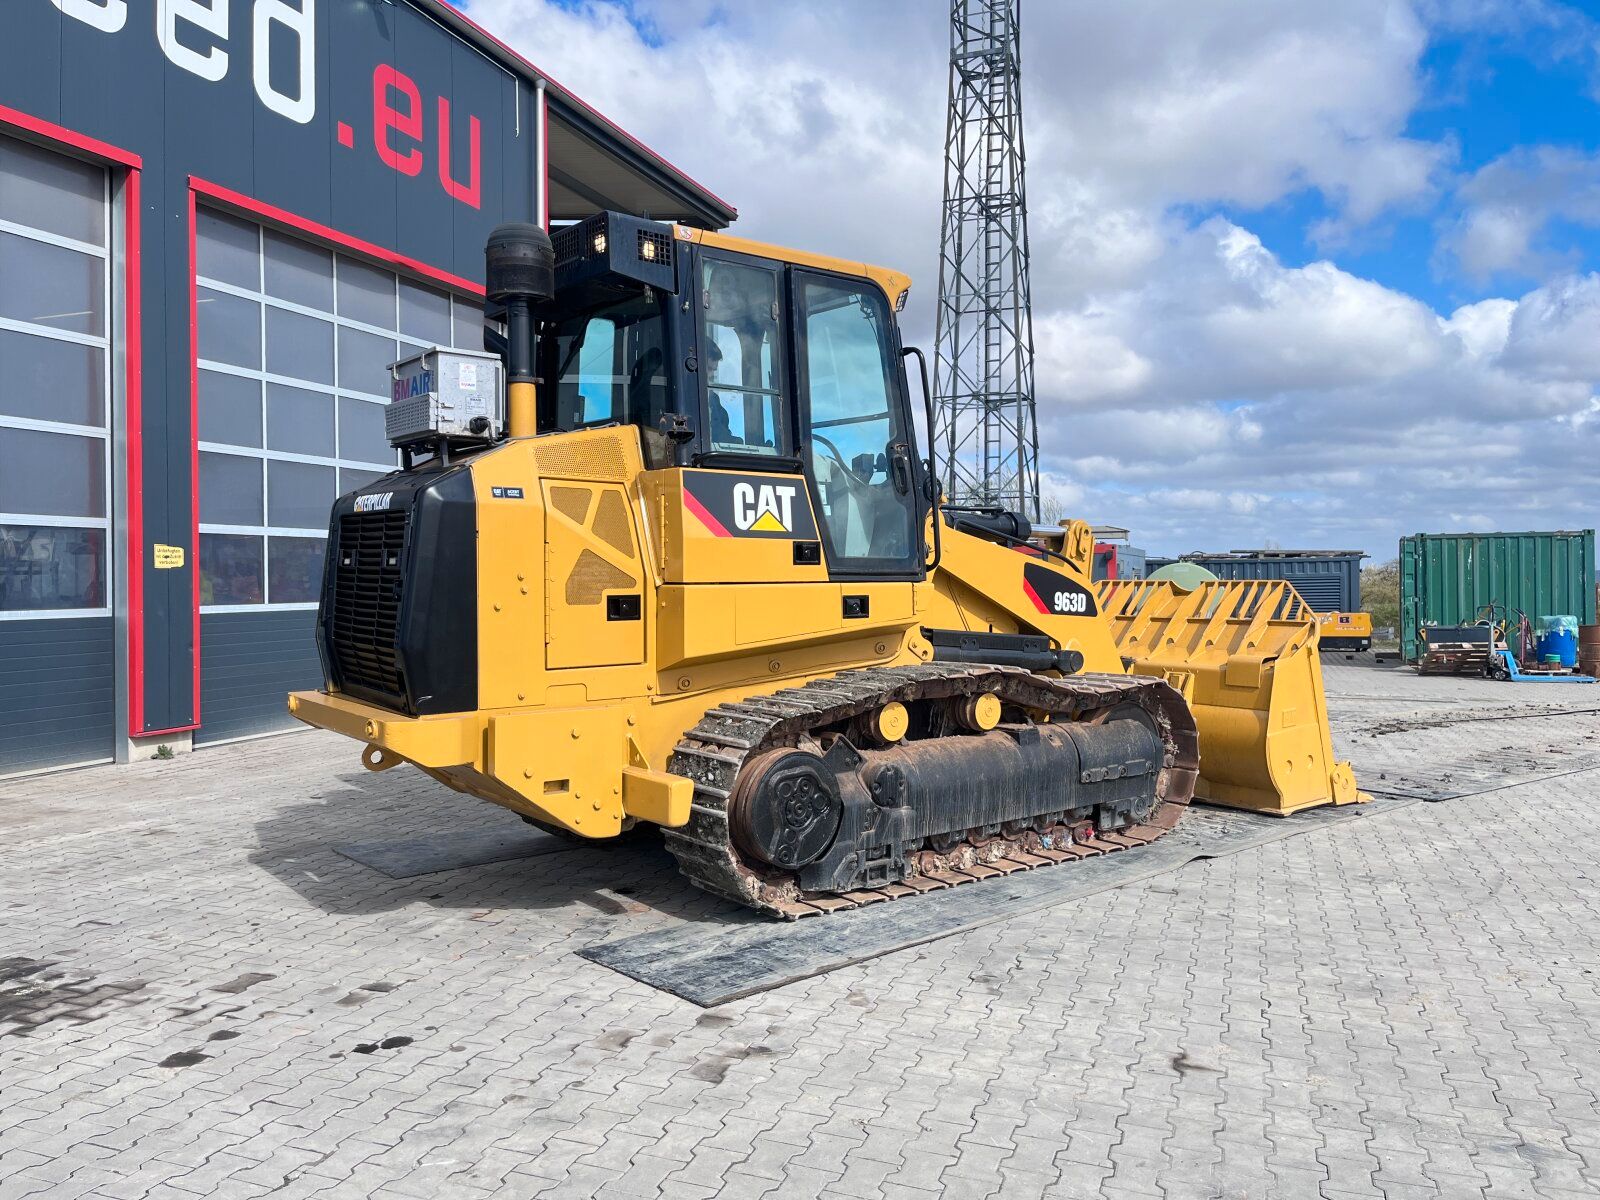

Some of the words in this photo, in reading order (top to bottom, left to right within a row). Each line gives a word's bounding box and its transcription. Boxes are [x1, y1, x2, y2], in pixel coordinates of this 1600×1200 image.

[50, 0, 482, 210] ed.eu
[354, 492, 394, 512] CATERPILLAR
[733, 482, 796, 532] CAT
[1054, 591, 1087, 612] 963D
